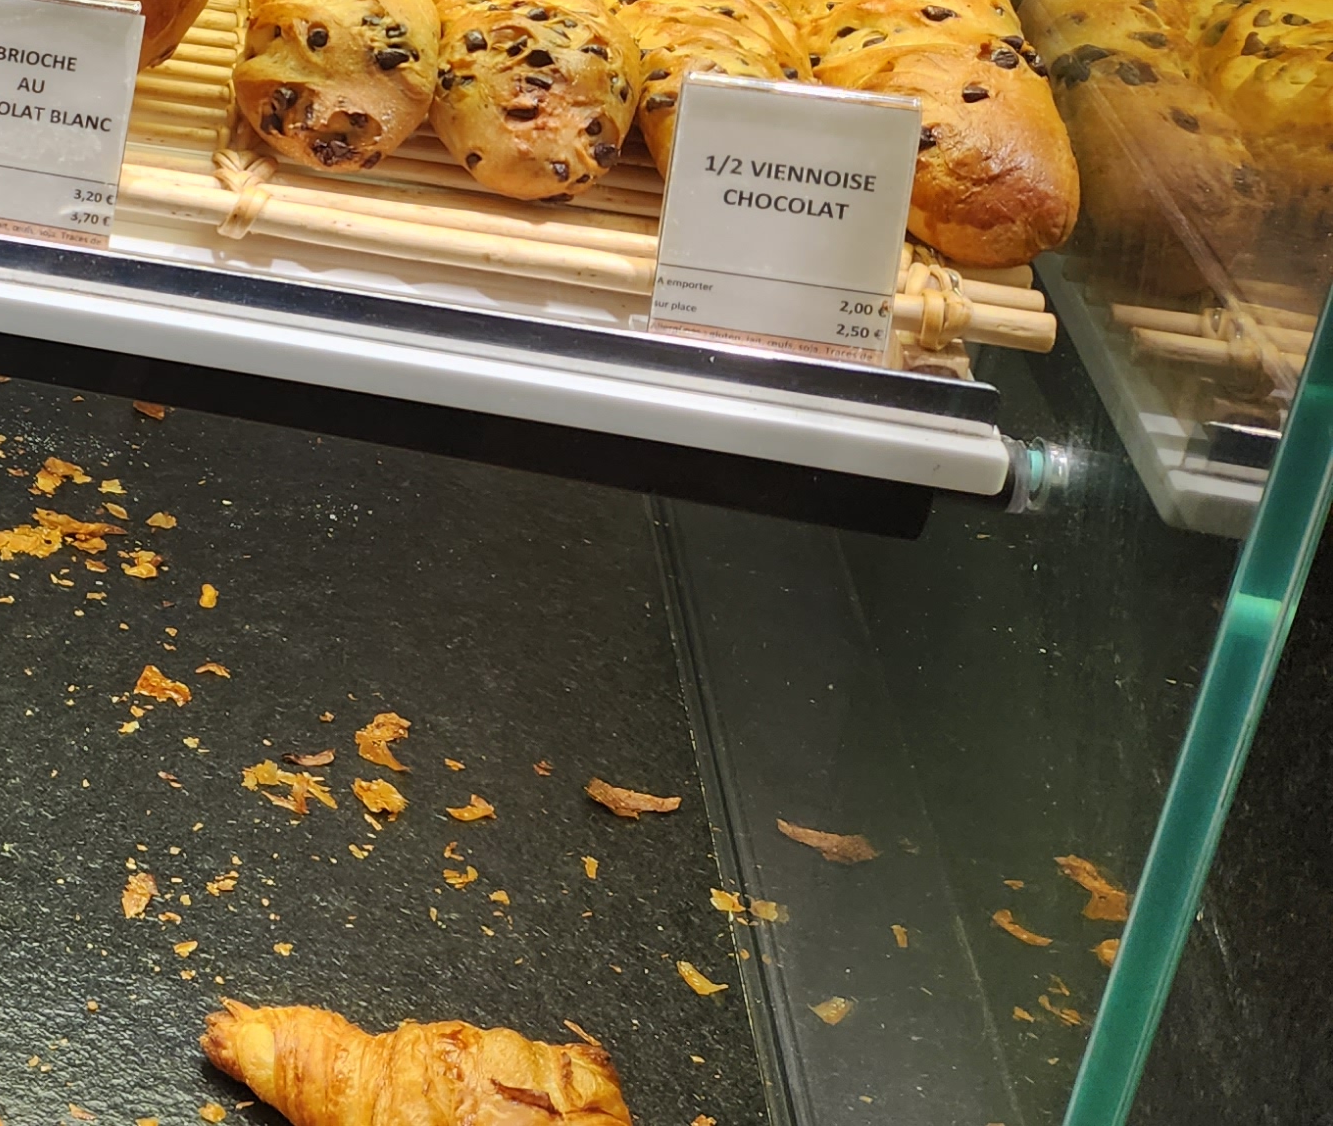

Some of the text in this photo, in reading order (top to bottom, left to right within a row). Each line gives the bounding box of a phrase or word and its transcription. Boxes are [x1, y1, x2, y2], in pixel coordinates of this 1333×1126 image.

[17, 77, 45, 94] AU
[50, 109, 113, 132] BLANC
[705, 154, 877, 192] 1/2 VIENNOISE
[73, 189, 102, 203] 3,20
[106, 194, 114, 205] €
[723, 188, 849, 220] CHOCOLAT
[70, 211, 99, 225] 3,70
[667, 279, 713, 292] emporter
[839, 301, 873, 316] 2,00
[654, 299, 883, 340] sur place 2,50 €
